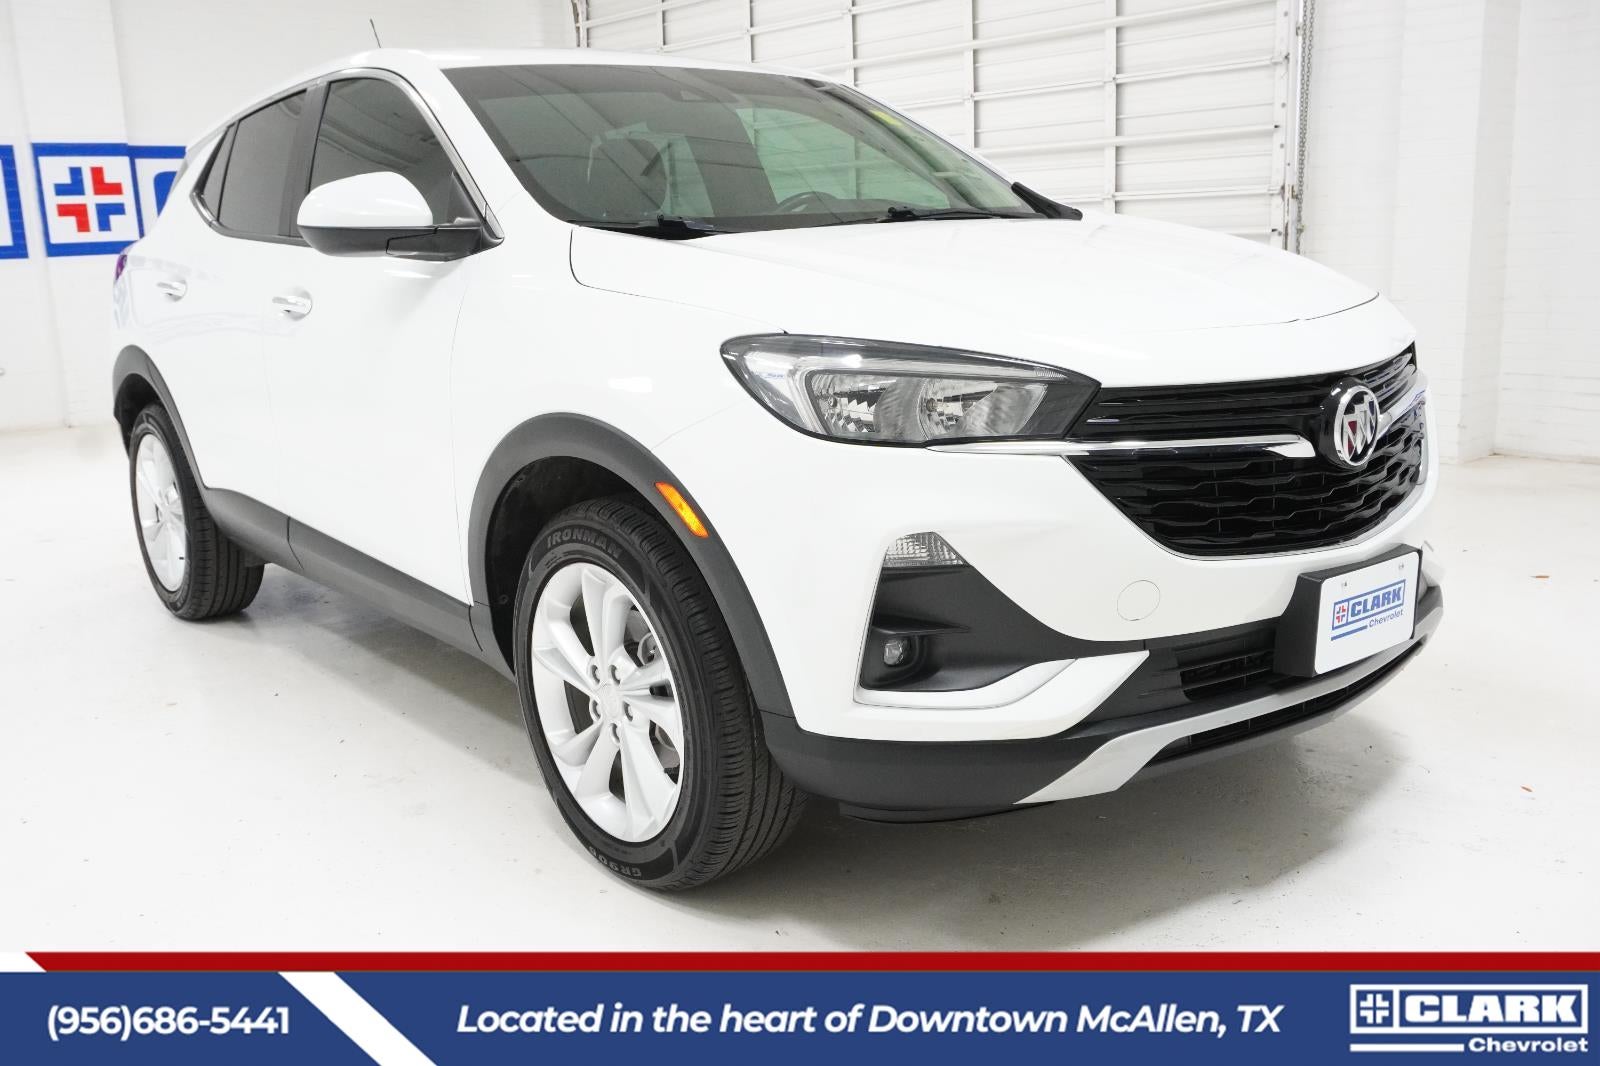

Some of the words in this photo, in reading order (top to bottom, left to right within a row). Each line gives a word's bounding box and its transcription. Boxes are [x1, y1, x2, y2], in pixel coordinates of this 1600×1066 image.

[547, 528, 621, 559] IRONMAN
[1350, 587, 1402, 618] CLARK
[1369, 609, 1404, 628] Chevrolet
